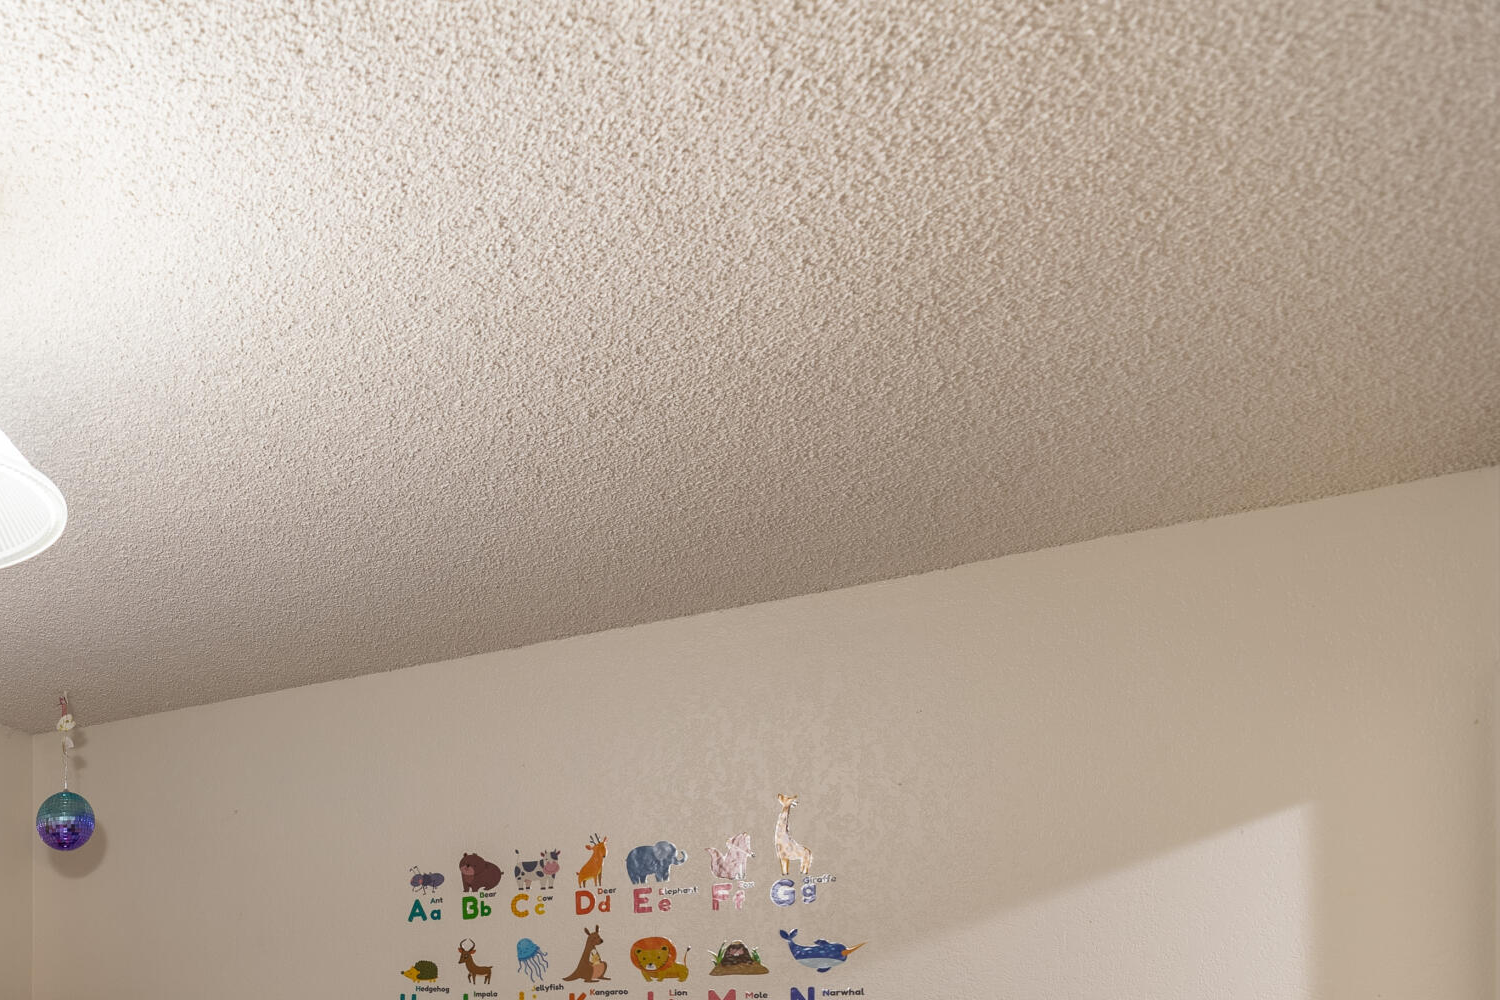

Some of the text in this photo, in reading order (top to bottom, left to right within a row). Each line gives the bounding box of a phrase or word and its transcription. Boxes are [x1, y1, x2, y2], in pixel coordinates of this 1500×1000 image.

[802, 875, 837, 884] Giraffe
[597, 887, 616, 895] Deer
[658, 886, 698, 896] Elephant
[415, 985, 450, 994] Hedgehog
[531, 984, 564, 993] Jellyfish
[589, 988, 629, 997] Kangaroo
[669, 989, 688, 997] Lion
[822, 987, 865, 997] Narwhal
[473, 991, 498, 999] Impala
[745, 991, 768, 999] Mole
